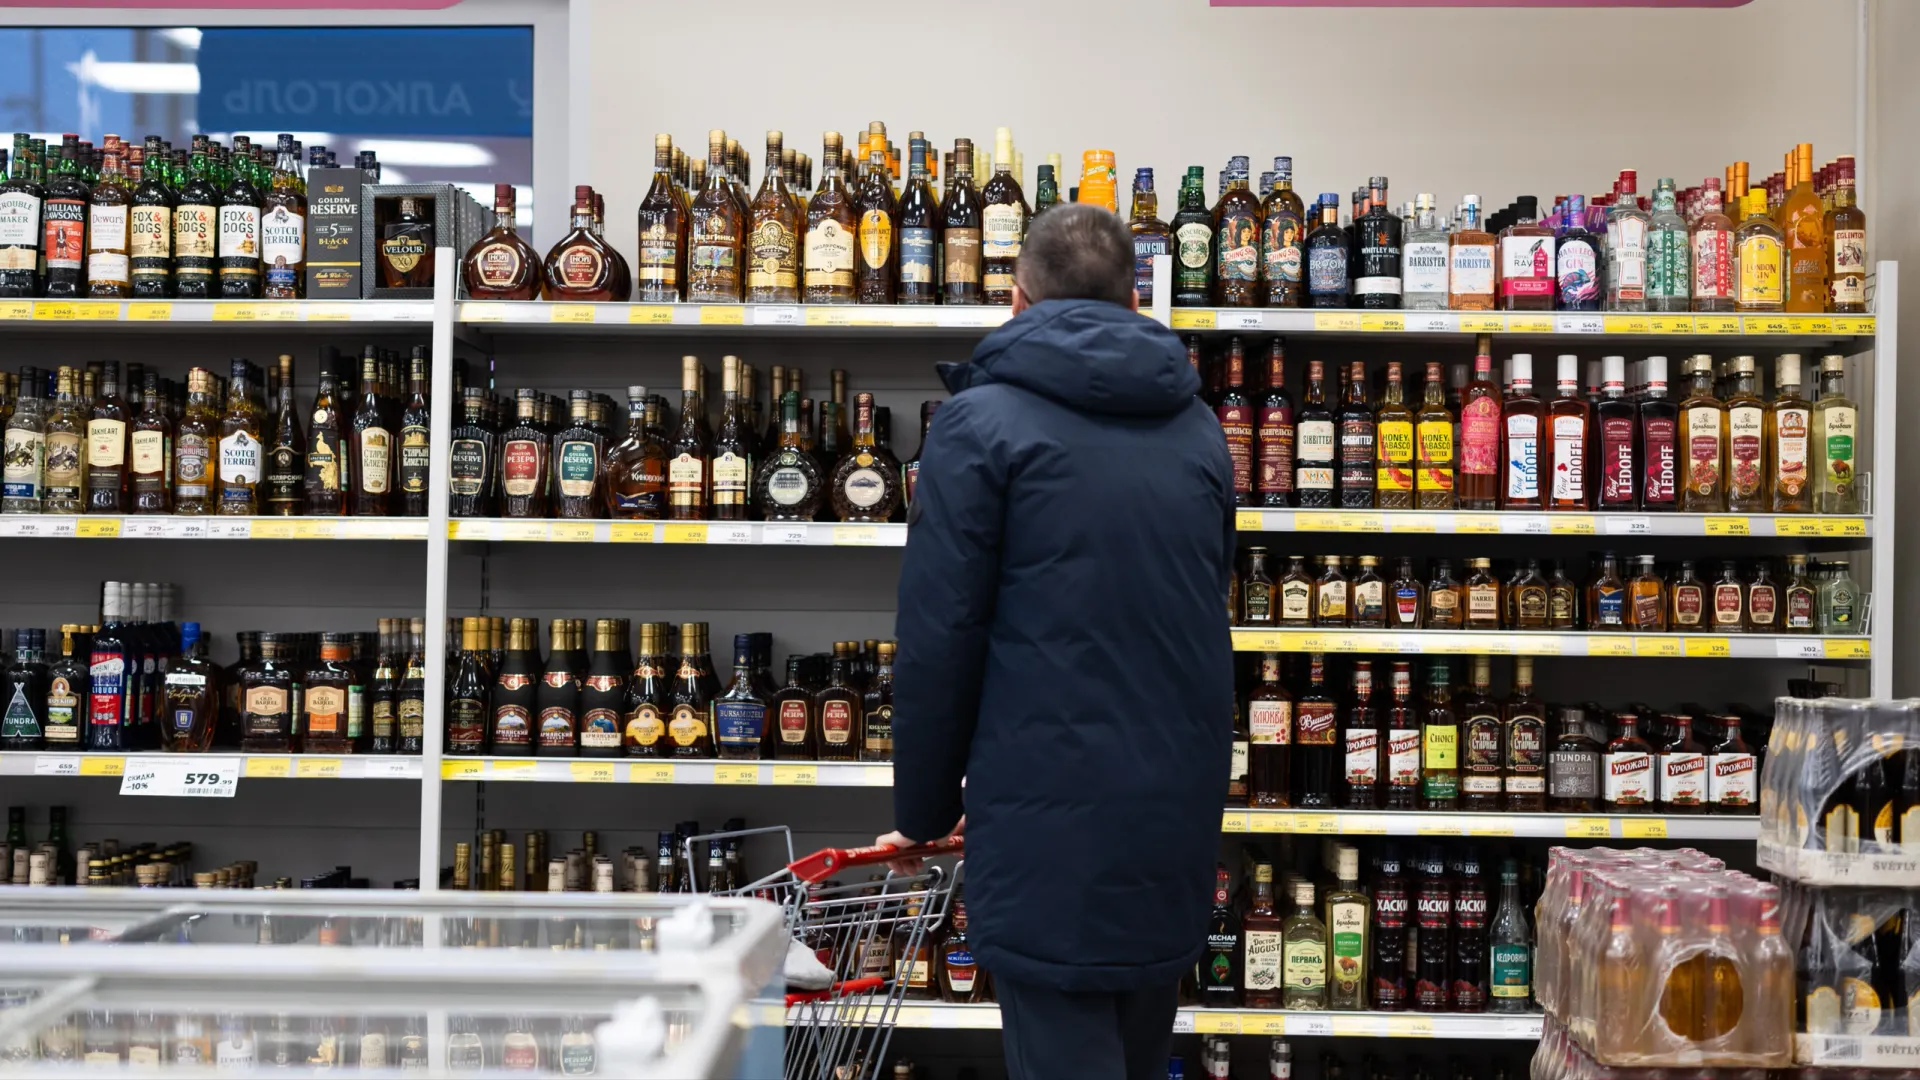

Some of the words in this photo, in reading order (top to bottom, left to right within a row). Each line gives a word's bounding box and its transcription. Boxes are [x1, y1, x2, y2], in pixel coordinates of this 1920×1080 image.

[48, 204, 82, 213] WILLIAM
[310, 204, 358, 214] RESERVE
[132, 222, 161, 233] DOGS
[178, 222, 206, 233] DOGS
[223, 222, 254, 233] DOGS
[265, 226, 298, 236] SCOTCH
[330, 223, 338, 237] 5
[264, 235, 300, 245] TERRIER
[641, 240, 676, 248] ЛЕЗГИНКА
[385, 246, 423, 254] VELOUR
[1134, 242, 1151, 255] HOLY
[1151, 242, 1166, 255] GUN
[1225, 251, 1244, 261] CHING
[1268, 252, 1287, 262] CHING
[1309, 259, 1346, 269] BROOM
[1409, 256, 1446, 267] BARRISTER
[1454, 258, 1491, 269] BARRISTER
[1514, 259, 1546, 267] RAVEN
[1566, 257, 1584, 269] GIN
[1746, 263, 1777, 274] LONDON
[91, 427, 119, 436] OAKHEART
[134, 437, 159, 445] OAKHEART
[1302, 435, 1333, 445] SIBBITTER
[1381, 441, 1410, 450] TABASCO
[1421, 441, 1450, 450] TABASCO
[224, 449, 255, 458] SCOTCH
[223, 457, 256, 467] TERRIER
[453, 455, 482, 463] RESERVE
[564, 456, 593, 464] RESERVE
[1525, 441, 1537, 491] LEDOFF
[1570, 442, 1583, 492] LEDOFF
[1619, 444, 1632, 494] LEDOFF
[1661, 445, 1674, 495] LEDOFF
[281, 485, 287, 493] 6
[1607, 476, 1618, 498] Graf
[1649, 476, 1661, 498] Graf
[5, 717, 36, 725] TUNDRA
[1253, 710, 1285, 724] КЛЮКВА
[1430, 733, 1454, 743] CHOICE
[1556, 754, 1592, 762] TUNDRA
[1613, 756, 1648, 774] Урожай
[1669, 757, 1704, 775] Урожай
[1717, 757, 1752, 775] Урожай
[127, 772, 156, 782] СКИДКА
[1377, 899, 1408, 911] ХАСКИ
[1417, 899, 1450, 912] ХАСКИ
[1455, 899, 1487, 912] ХАСКИ
[1207, 934, 1237, 942] ЛЕСНАЯ
[1253, 938, 1276, 946] DOCTOR
[1247, 943, 1280, 956] AUGUST
[1291, 955, 1323, 964] ПЕРВАКЪ
